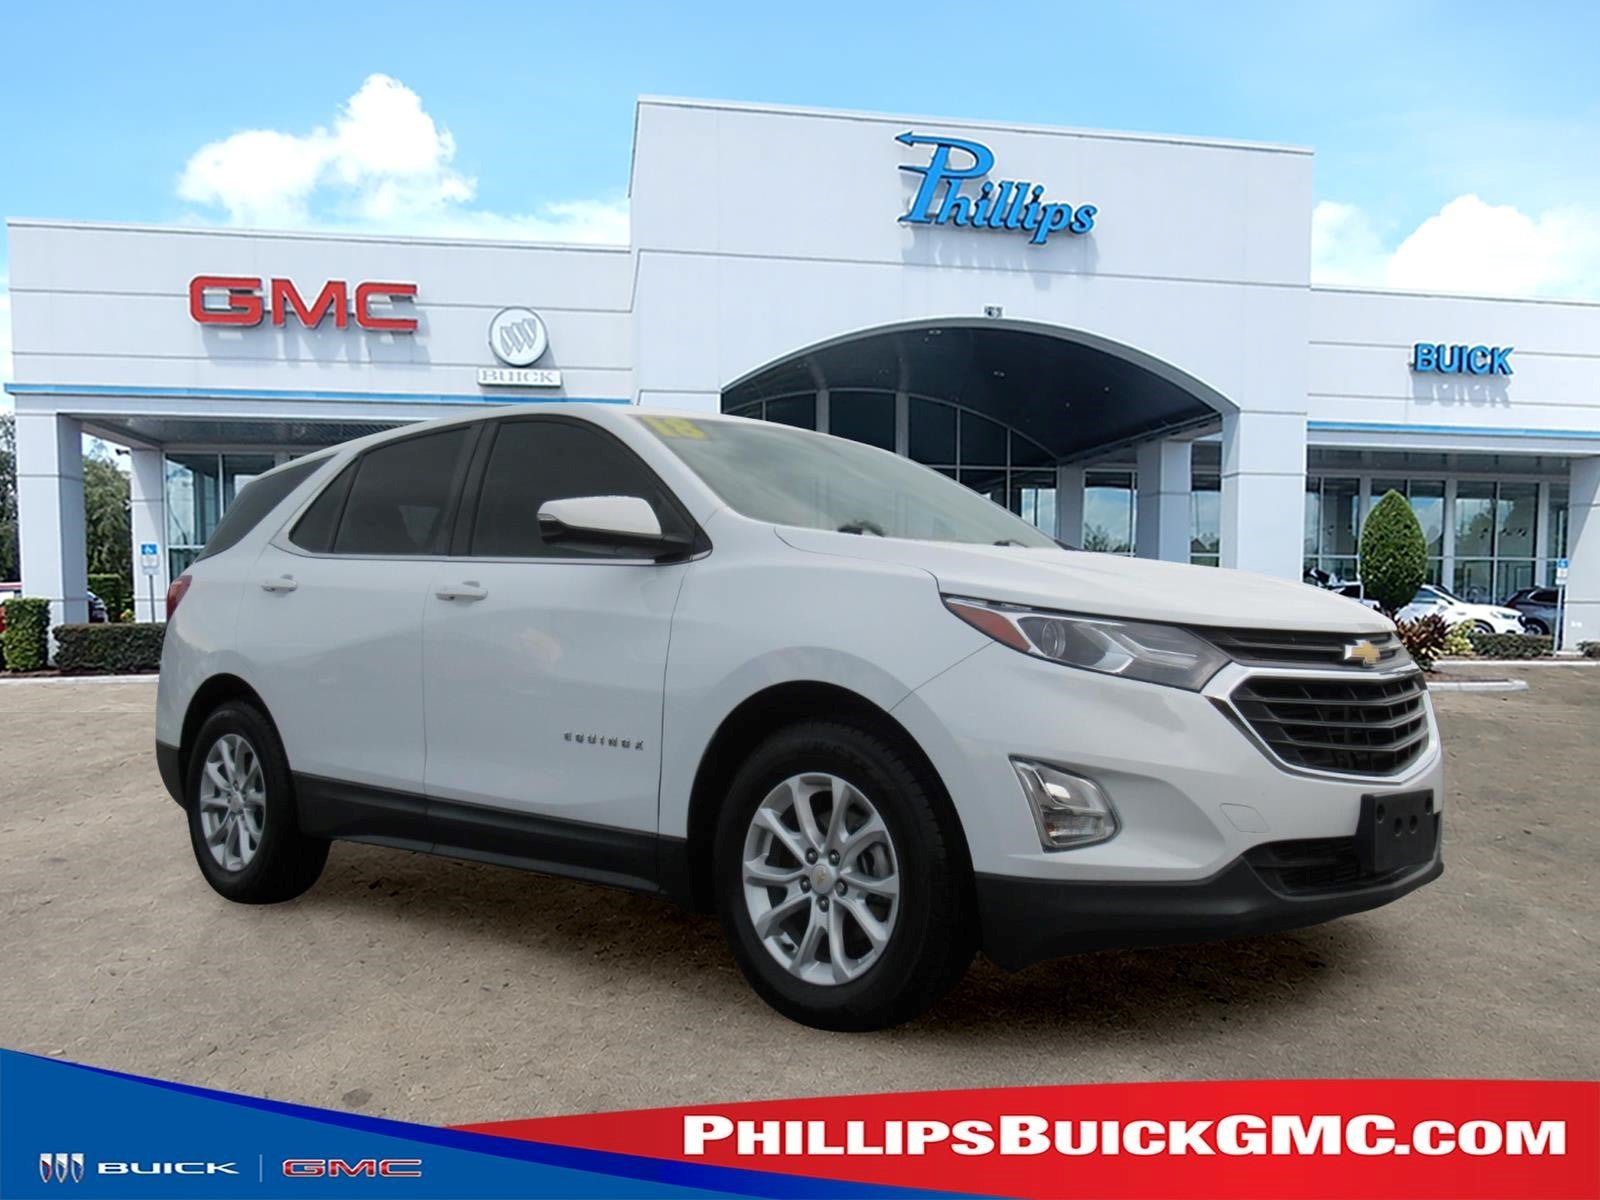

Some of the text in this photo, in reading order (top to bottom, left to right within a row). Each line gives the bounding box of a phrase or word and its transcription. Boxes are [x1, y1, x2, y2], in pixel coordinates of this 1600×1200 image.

[895, 131, 1098, 245] Phillips
[189, 275, 418, 333] GMC
[1412, 343, 1514, 375] BUICK
[482, 370, 555, 383] BUICK
[563, 732, 644, 751] EQUINOX
